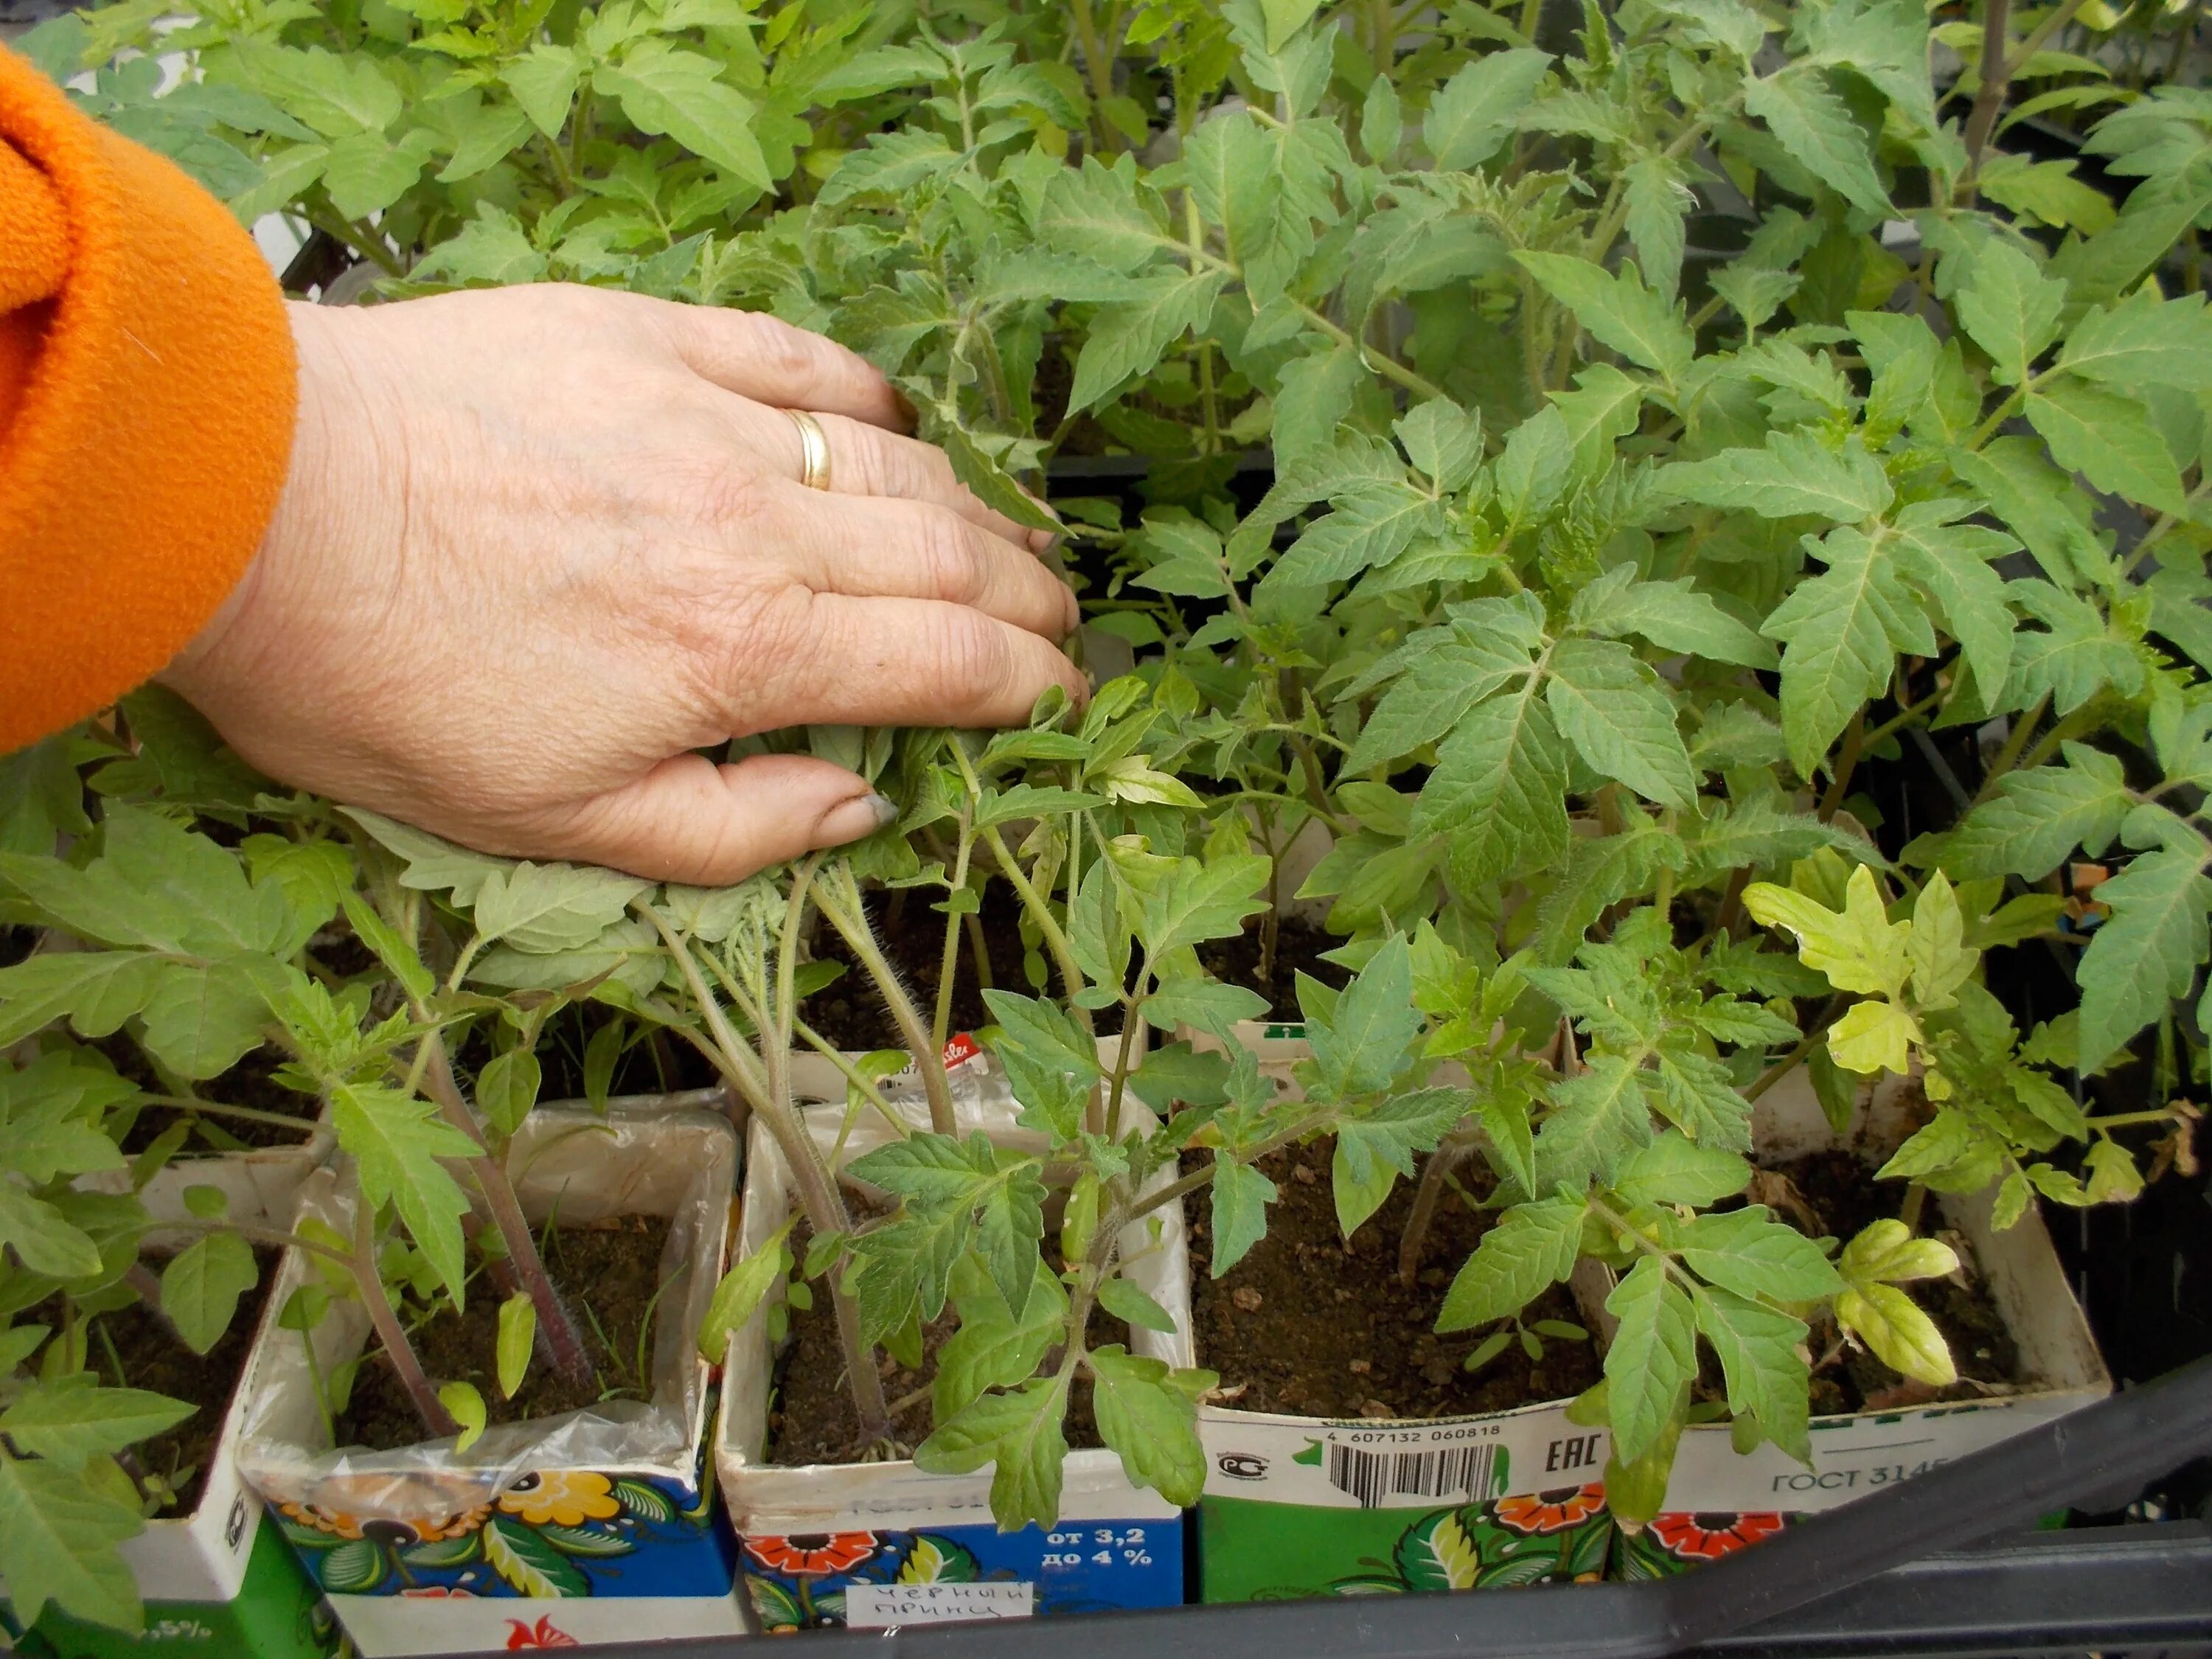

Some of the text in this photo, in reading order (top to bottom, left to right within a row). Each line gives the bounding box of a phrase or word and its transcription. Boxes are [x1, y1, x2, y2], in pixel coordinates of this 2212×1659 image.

[1327, 1425, 1500, 1442] 4 607132 060818
[1773, 1470, 1861, 1492] ГОСТ
[1046, 1528, 1145, 1546] от 3,2
[1041, 1549, 1152, 1566] до 4 %
